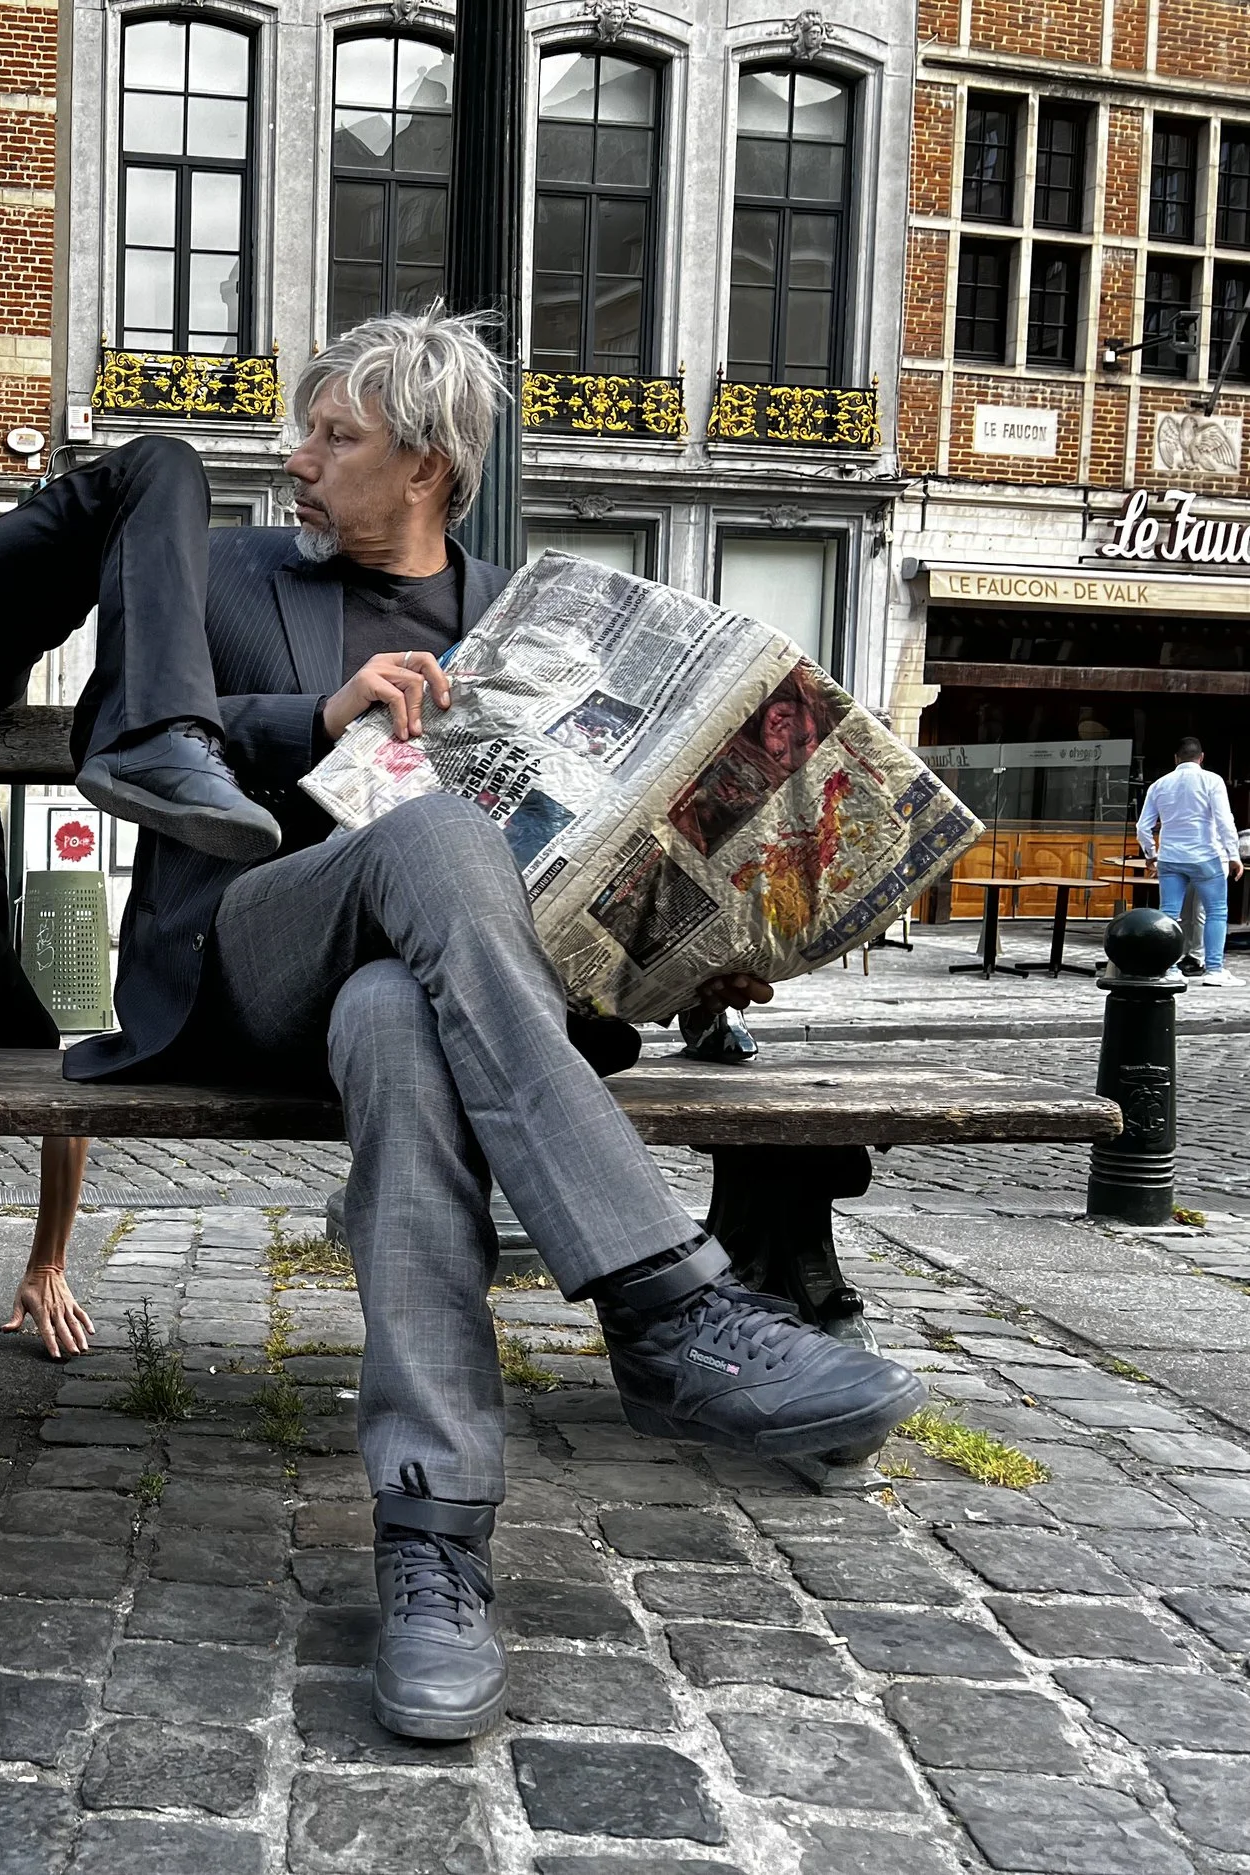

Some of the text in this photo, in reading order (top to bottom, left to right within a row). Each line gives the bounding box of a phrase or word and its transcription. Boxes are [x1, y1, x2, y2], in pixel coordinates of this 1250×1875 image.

[984, 422, 1048, 442] LE FAUCON
[1102, 489, 1159, 560] Le
[950, 576, 971, 594] LE
[977, 577, 1058, 598] FAUCON
[1074, 582, 1098, 600] DE
[1103, 584, 1149, 603] VALK
[505, 745, 529, 766] ik
[486, 761, 516, 794] kan
[689, 1348, 727, 1370] Reebok
